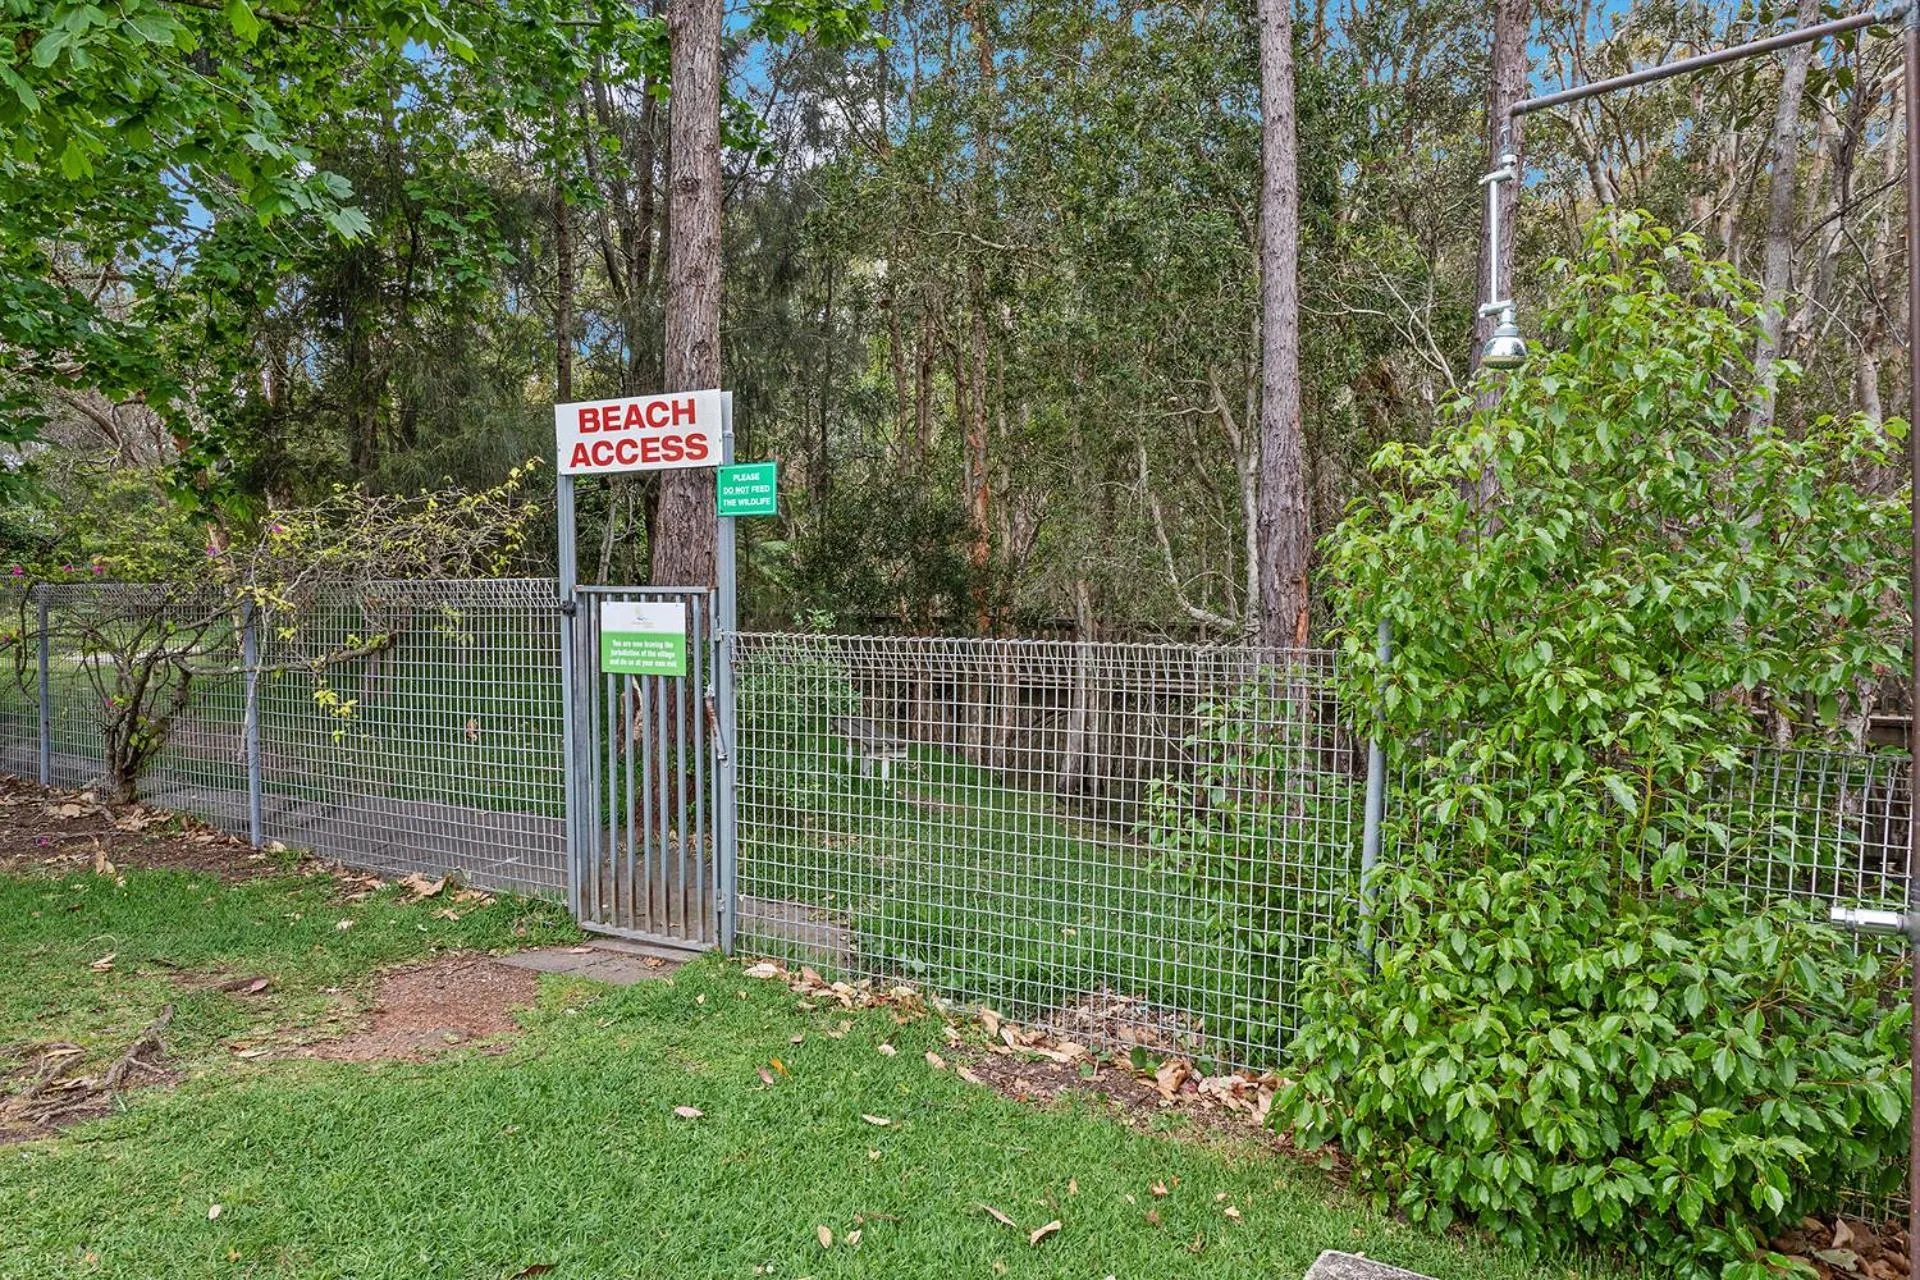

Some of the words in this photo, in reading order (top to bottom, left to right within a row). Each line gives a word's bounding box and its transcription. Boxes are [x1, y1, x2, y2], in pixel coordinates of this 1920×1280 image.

[579, 399, 695, 433] BEACH
[570, 433, 708, 467] ACCESS
[733, 473, 760, 481] PLEASE
[723, 487, 734, 495] DO
[735, 486, 750, 495] NOT
[751, 484, 770, 493] FEED
[738, 498, 771, 506] WILDLIFE
